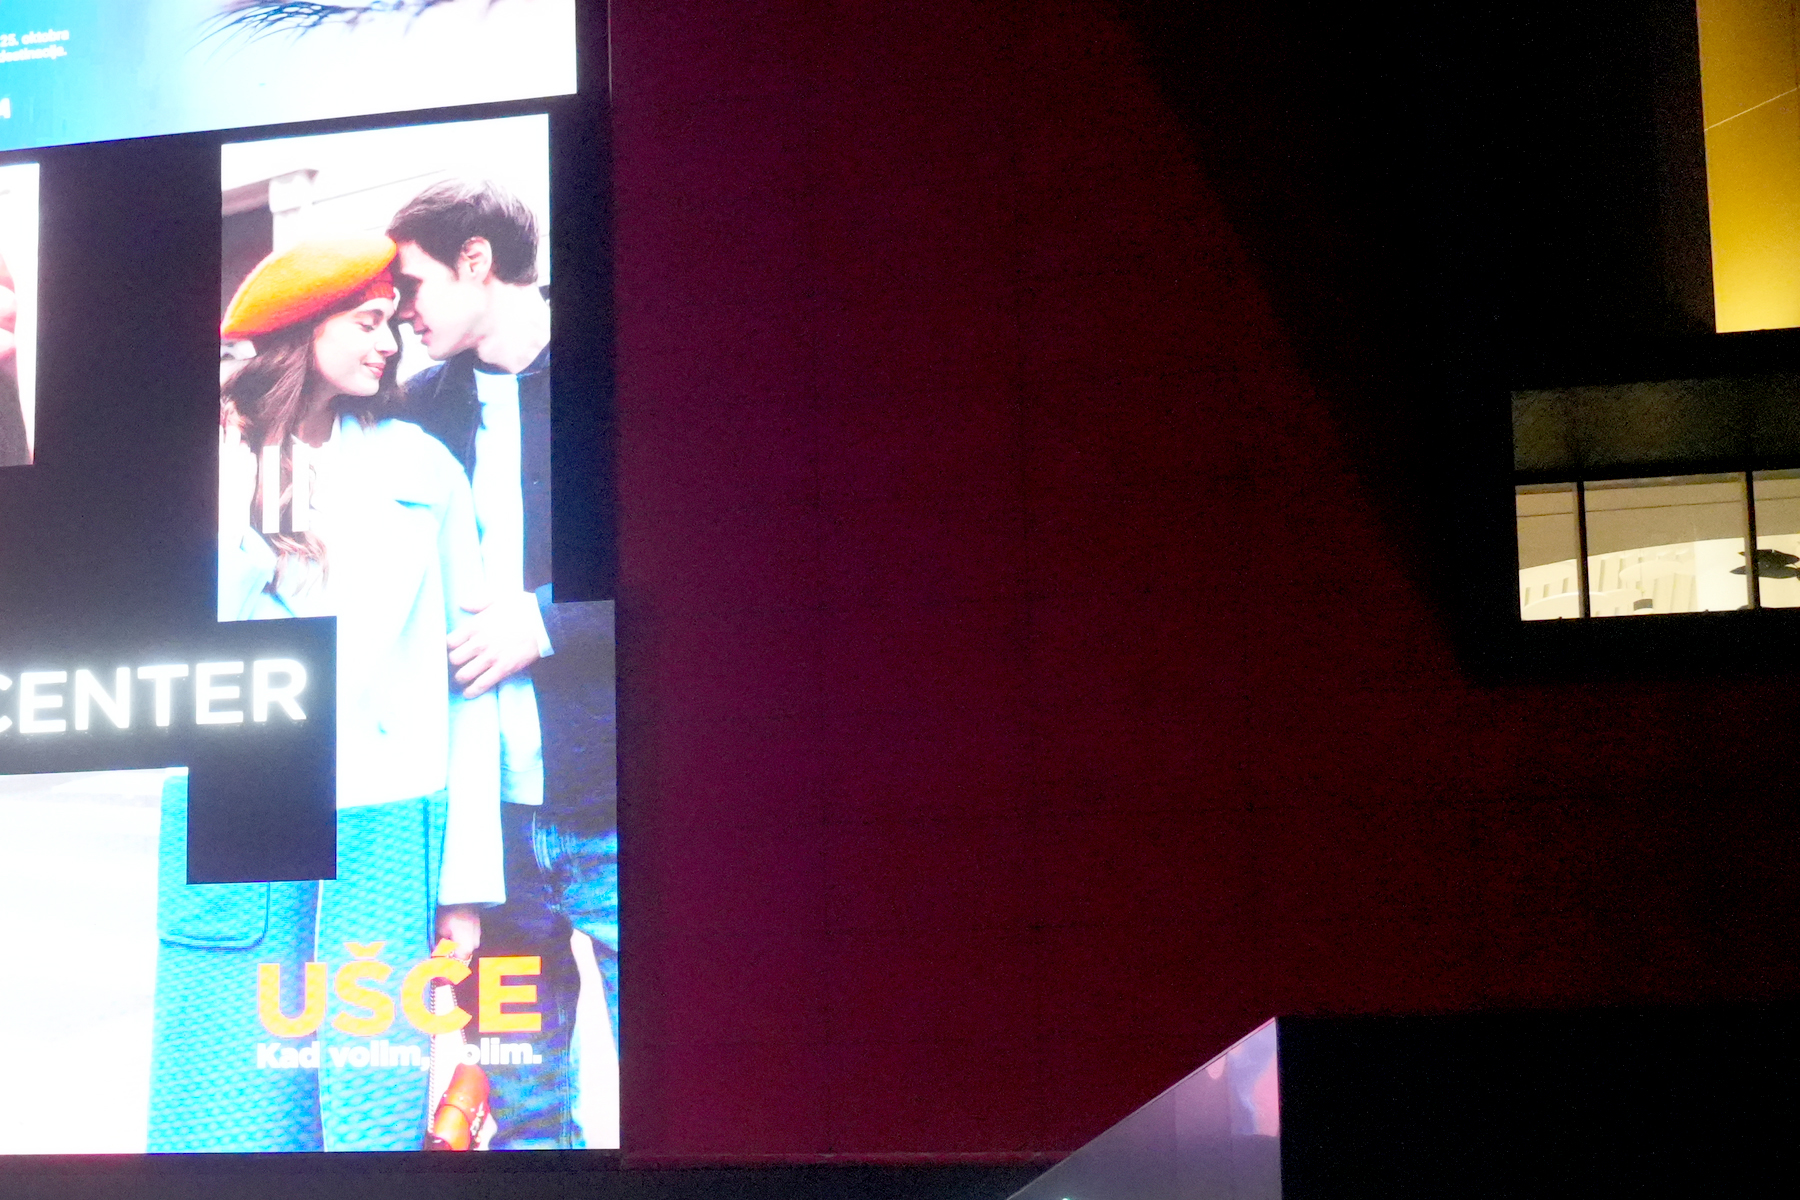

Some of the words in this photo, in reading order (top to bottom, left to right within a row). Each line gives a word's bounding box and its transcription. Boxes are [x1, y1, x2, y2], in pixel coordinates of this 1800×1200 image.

[0, 33, 19, 47] 25.
[258, 938, 542, 1038] UŠĆE
[257, 1040, 320, 1069] Kad
[329, 1039, 431, 1071] volim,
[440, 1037, 542, 1066] olim.
